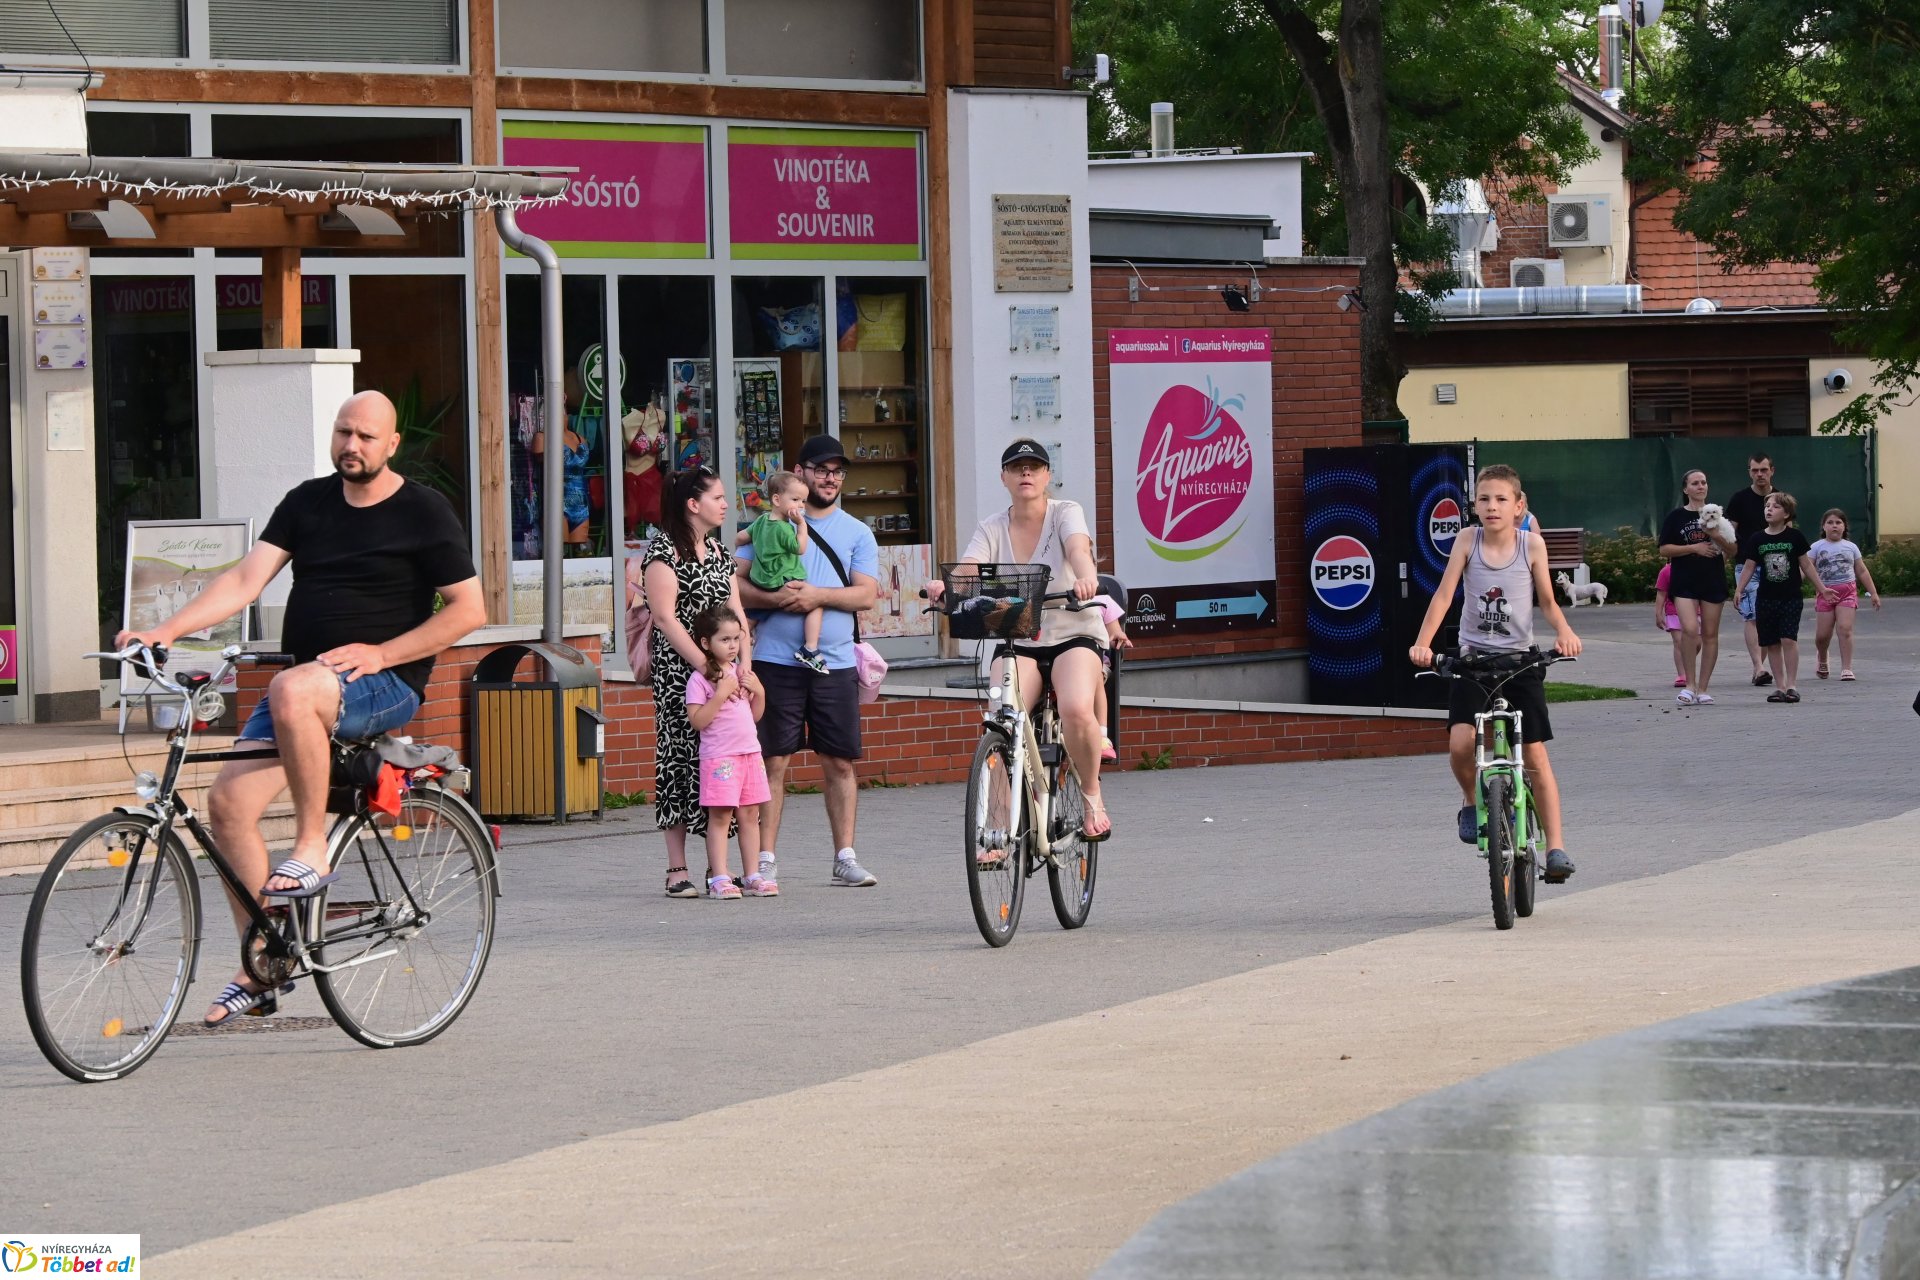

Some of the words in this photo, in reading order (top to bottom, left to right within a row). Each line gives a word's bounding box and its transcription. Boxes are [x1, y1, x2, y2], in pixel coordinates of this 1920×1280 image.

[773, 153, 871, 183] VINOTÉKA
[571, 175, 640, 208] SÓSTÓ
[815, 185, 831, 210] &
[777, 212, 875, 237] SOUVENIR
[1115, 341, 1169, 353] aquariusspa.hu
[1191, 341, 1221, 353] Aquarius
[1222, 340, 1265, 352] Nyíregyháza
[1136, 422, 1251, 541] Aquarius
[1181, 479, 1248, 496] NYÍREGYHÁZA
[1432, 521, 1460, 534] PEPSI
[1315, 564, 1371, 581] PEPSI
[1209, 602, 1219, 613] 50
[1220, 604, 1228, 612] m
[1126, 614, 1142, 624] HOTEL
